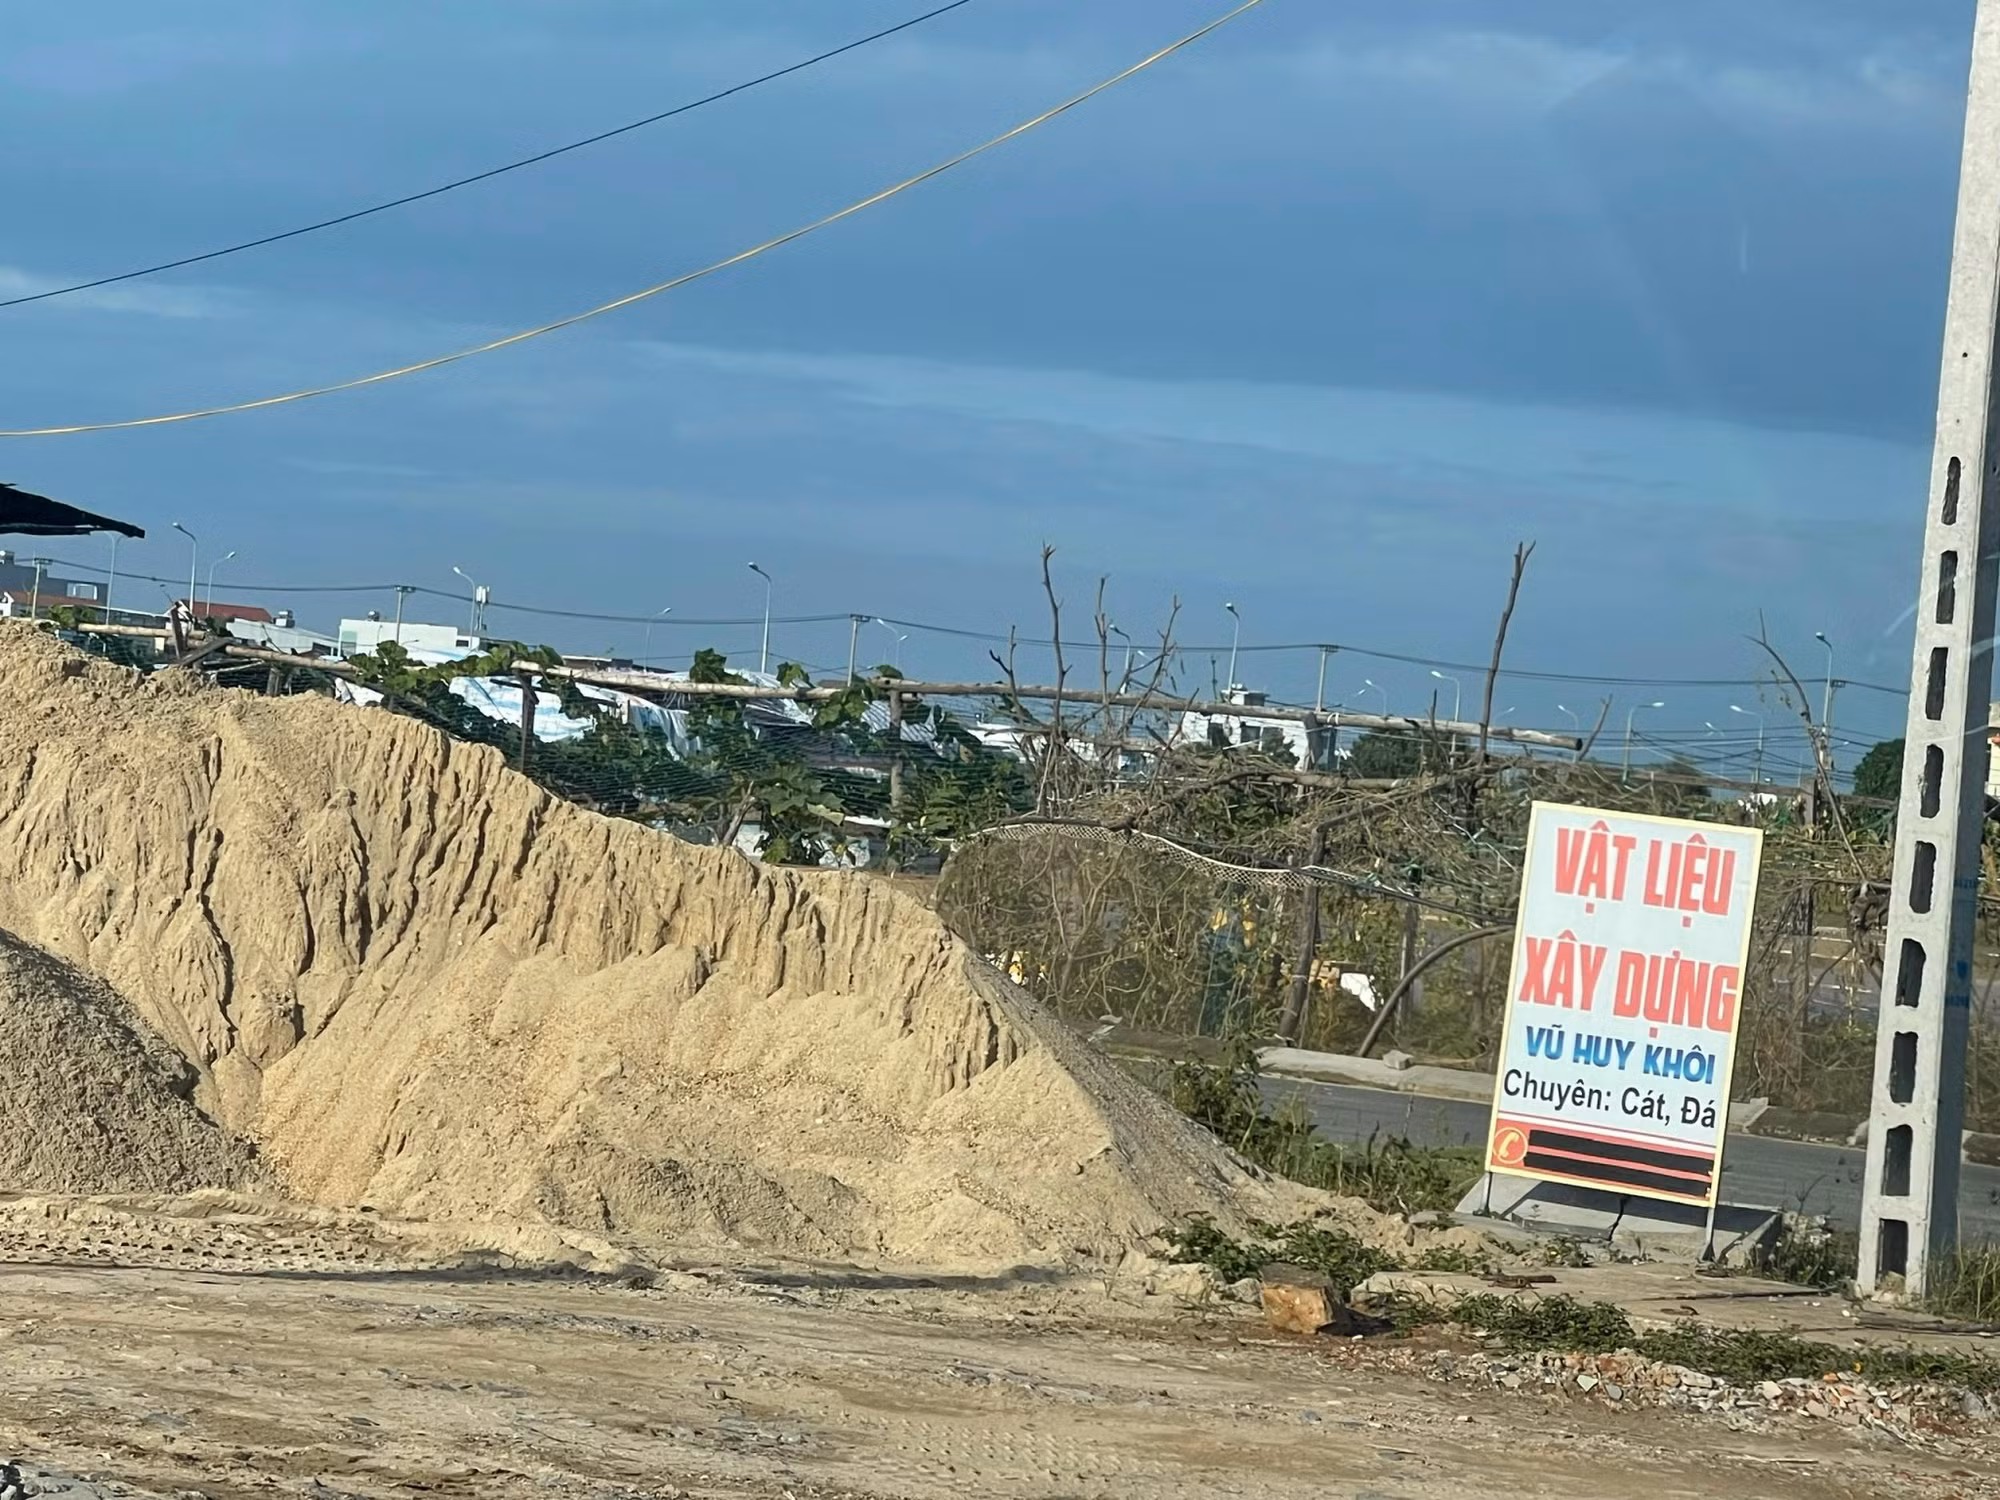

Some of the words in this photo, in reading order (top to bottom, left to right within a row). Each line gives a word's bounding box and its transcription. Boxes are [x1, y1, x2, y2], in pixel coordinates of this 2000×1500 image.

[1555, 820, 1637, 914] VẬT
[1643, 833, 1736, 928] LIỆU
[1519, 929, 1608, 1011] XÂY
[1613, 950, 1739, 1038] DỰNG
[1526, 1024, 1565, 1060] VŨ
[1573, 1033, 1635, 1070] HUY
[1643, 1045, 1716, 1084] KHÔI
[1504, 1069, 1611, 1111] Chuyên:
[1621, 1087, 1670, 1126] Cát,
[1681, 1096, 1716, 1128] Đá
